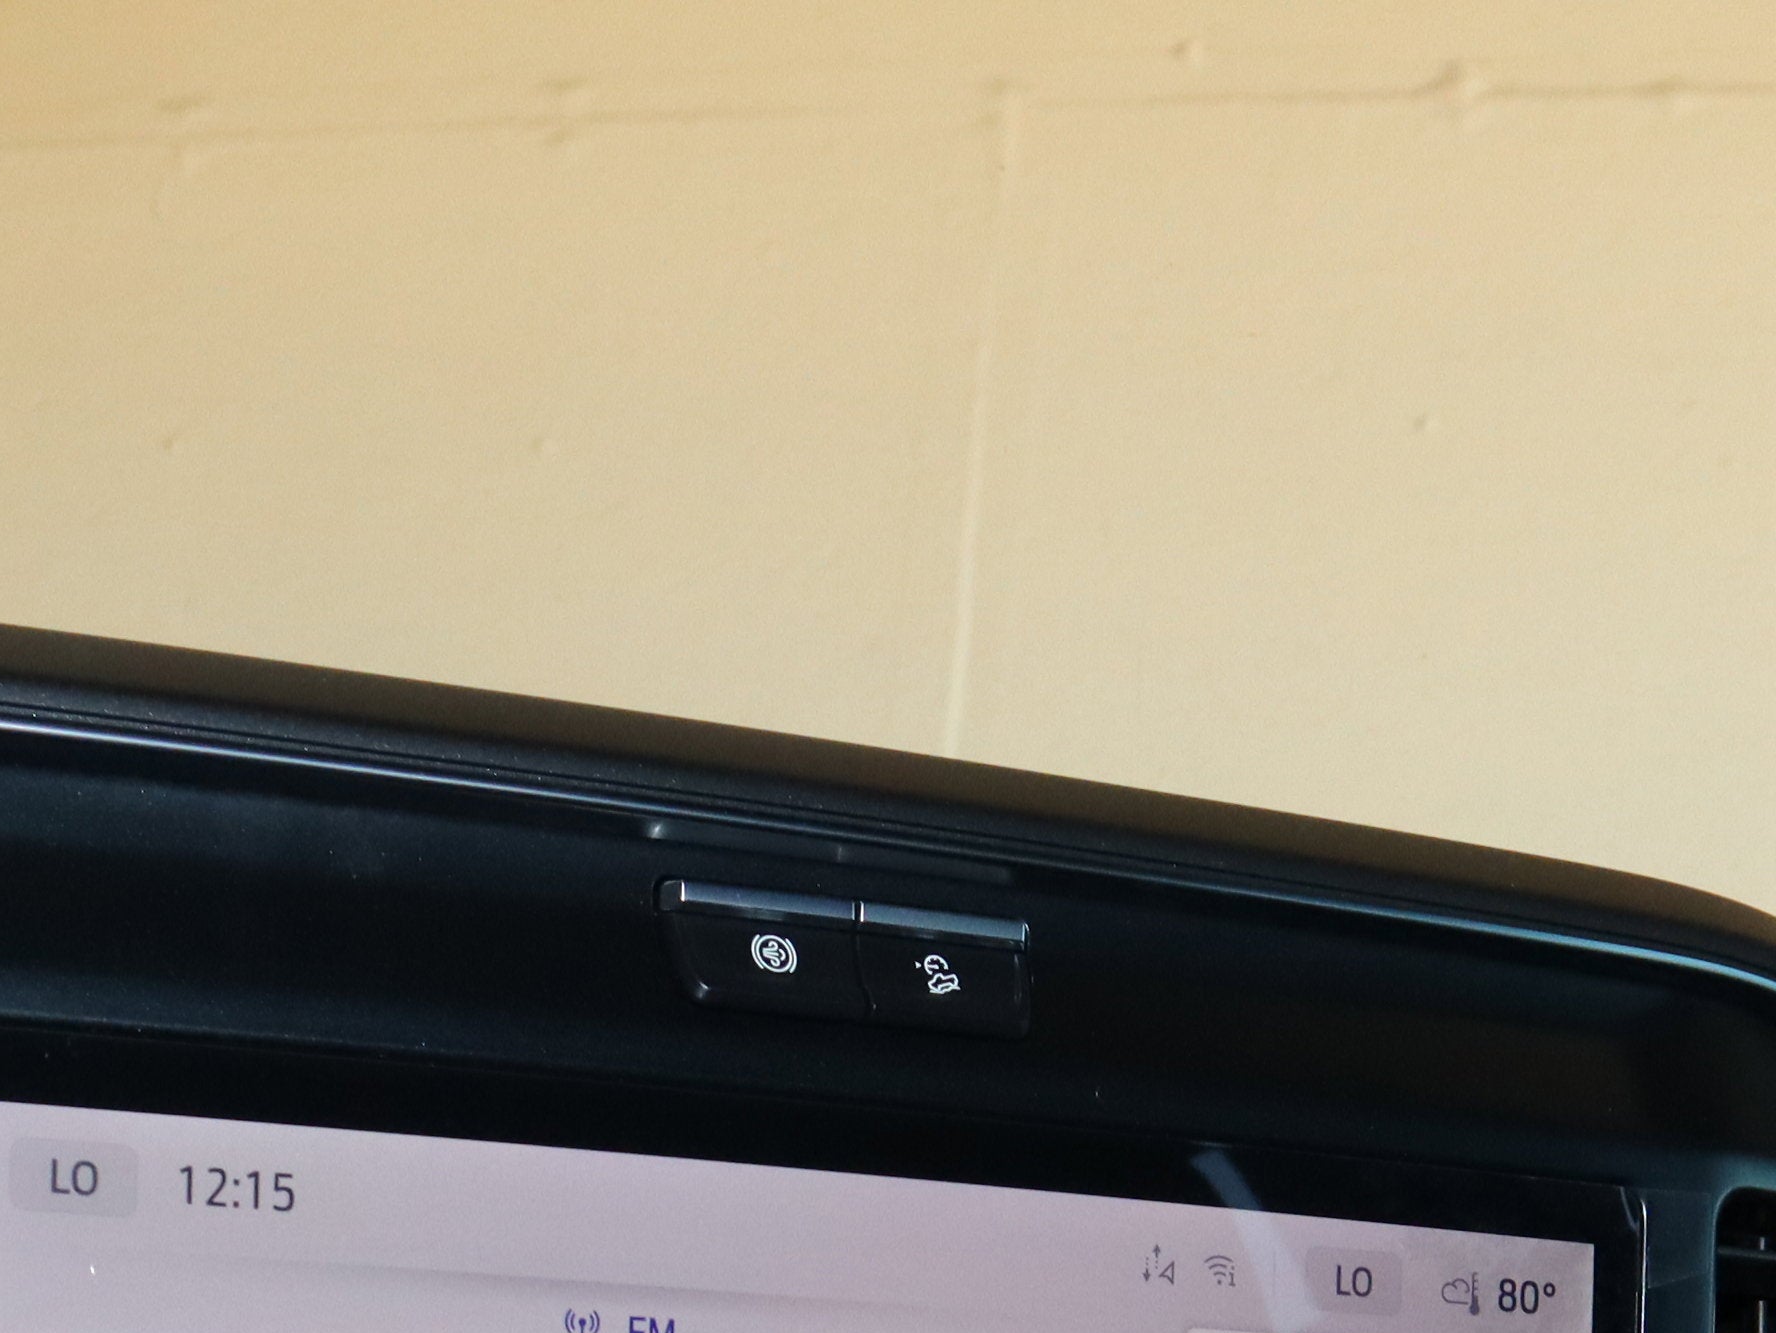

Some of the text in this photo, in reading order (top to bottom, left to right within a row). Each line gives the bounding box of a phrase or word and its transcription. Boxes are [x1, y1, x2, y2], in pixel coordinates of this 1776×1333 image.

[50, 1159, 98, 1195] LO
[180, 1166, 296, 1211] 12:15
[1336, 1265, 1373, 1297] LO
